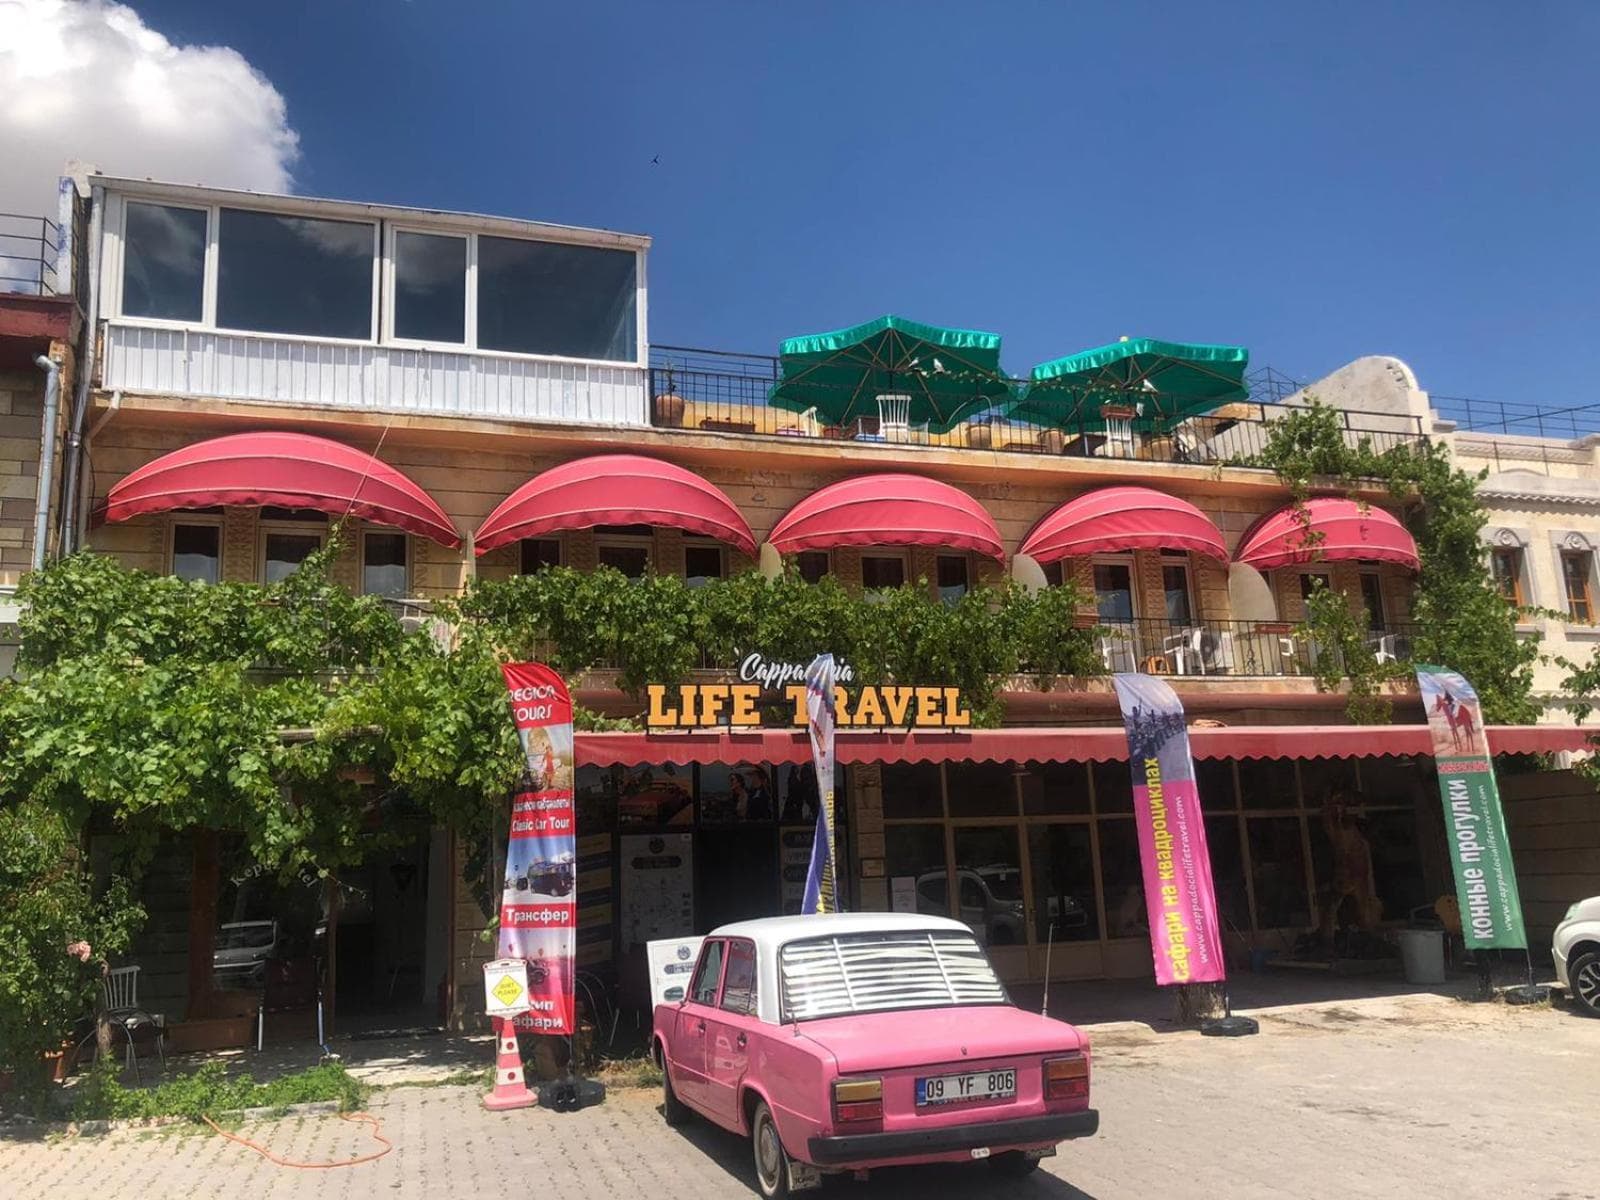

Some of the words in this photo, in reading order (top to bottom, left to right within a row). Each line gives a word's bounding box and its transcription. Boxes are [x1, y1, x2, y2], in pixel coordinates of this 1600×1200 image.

[740, 653, 855, 690] Cappaia
[647, 685, 760, 725] LIFE
[785, 685, 970, 725] TRAVEL
[549, 816, 570, 829] Tour
[1144, 757, 1176, 880] квадроциклах
[1448, 779, 1485, 863] прогулки
[1161, 885, 1179, 906] на
[1463, 868, 1495, 939] конные
[505, 908, 569, 925] Трансфер
[1165, 912, 1192, 982] сафари
[512, 1015, 563, 1030] афари
[927, 1080, 944, 1098] 09
[958, 1077, 974, 1095] YF
[988, 1072, 1013, 1091] 806
